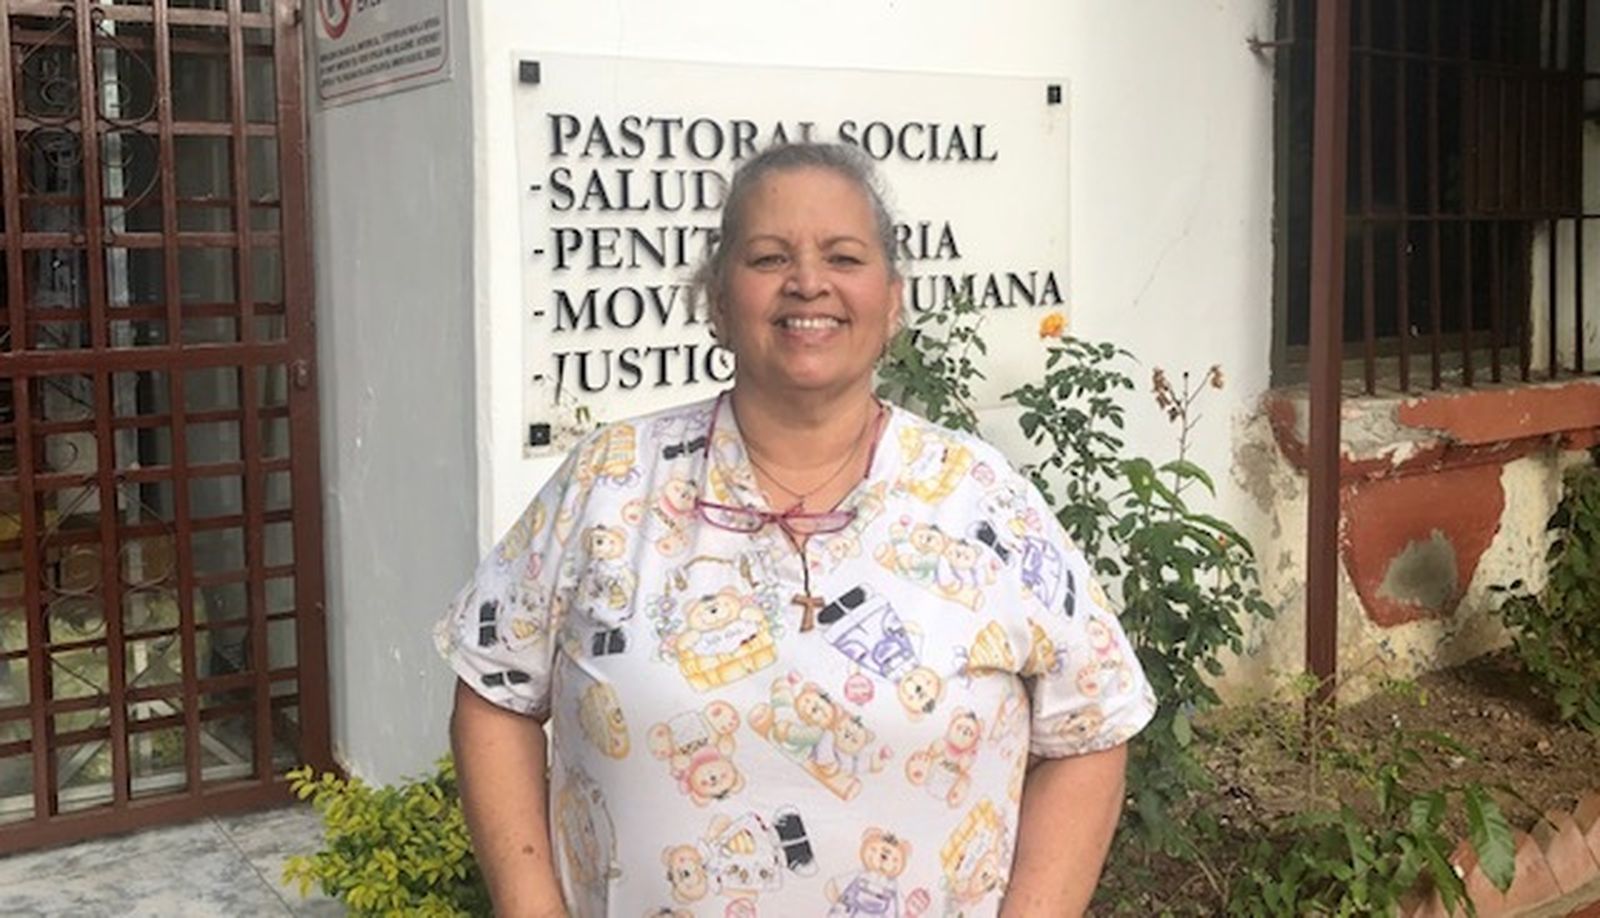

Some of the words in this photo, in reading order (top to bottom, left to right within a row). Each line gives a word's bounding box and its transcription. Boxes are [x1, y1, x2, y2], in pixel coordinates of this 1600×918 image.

[838, 120, 999, 162] SOCIAL
[909, 270, 1064, 313] UMANA
[533, 344, 736, 405] -JUSTIC
